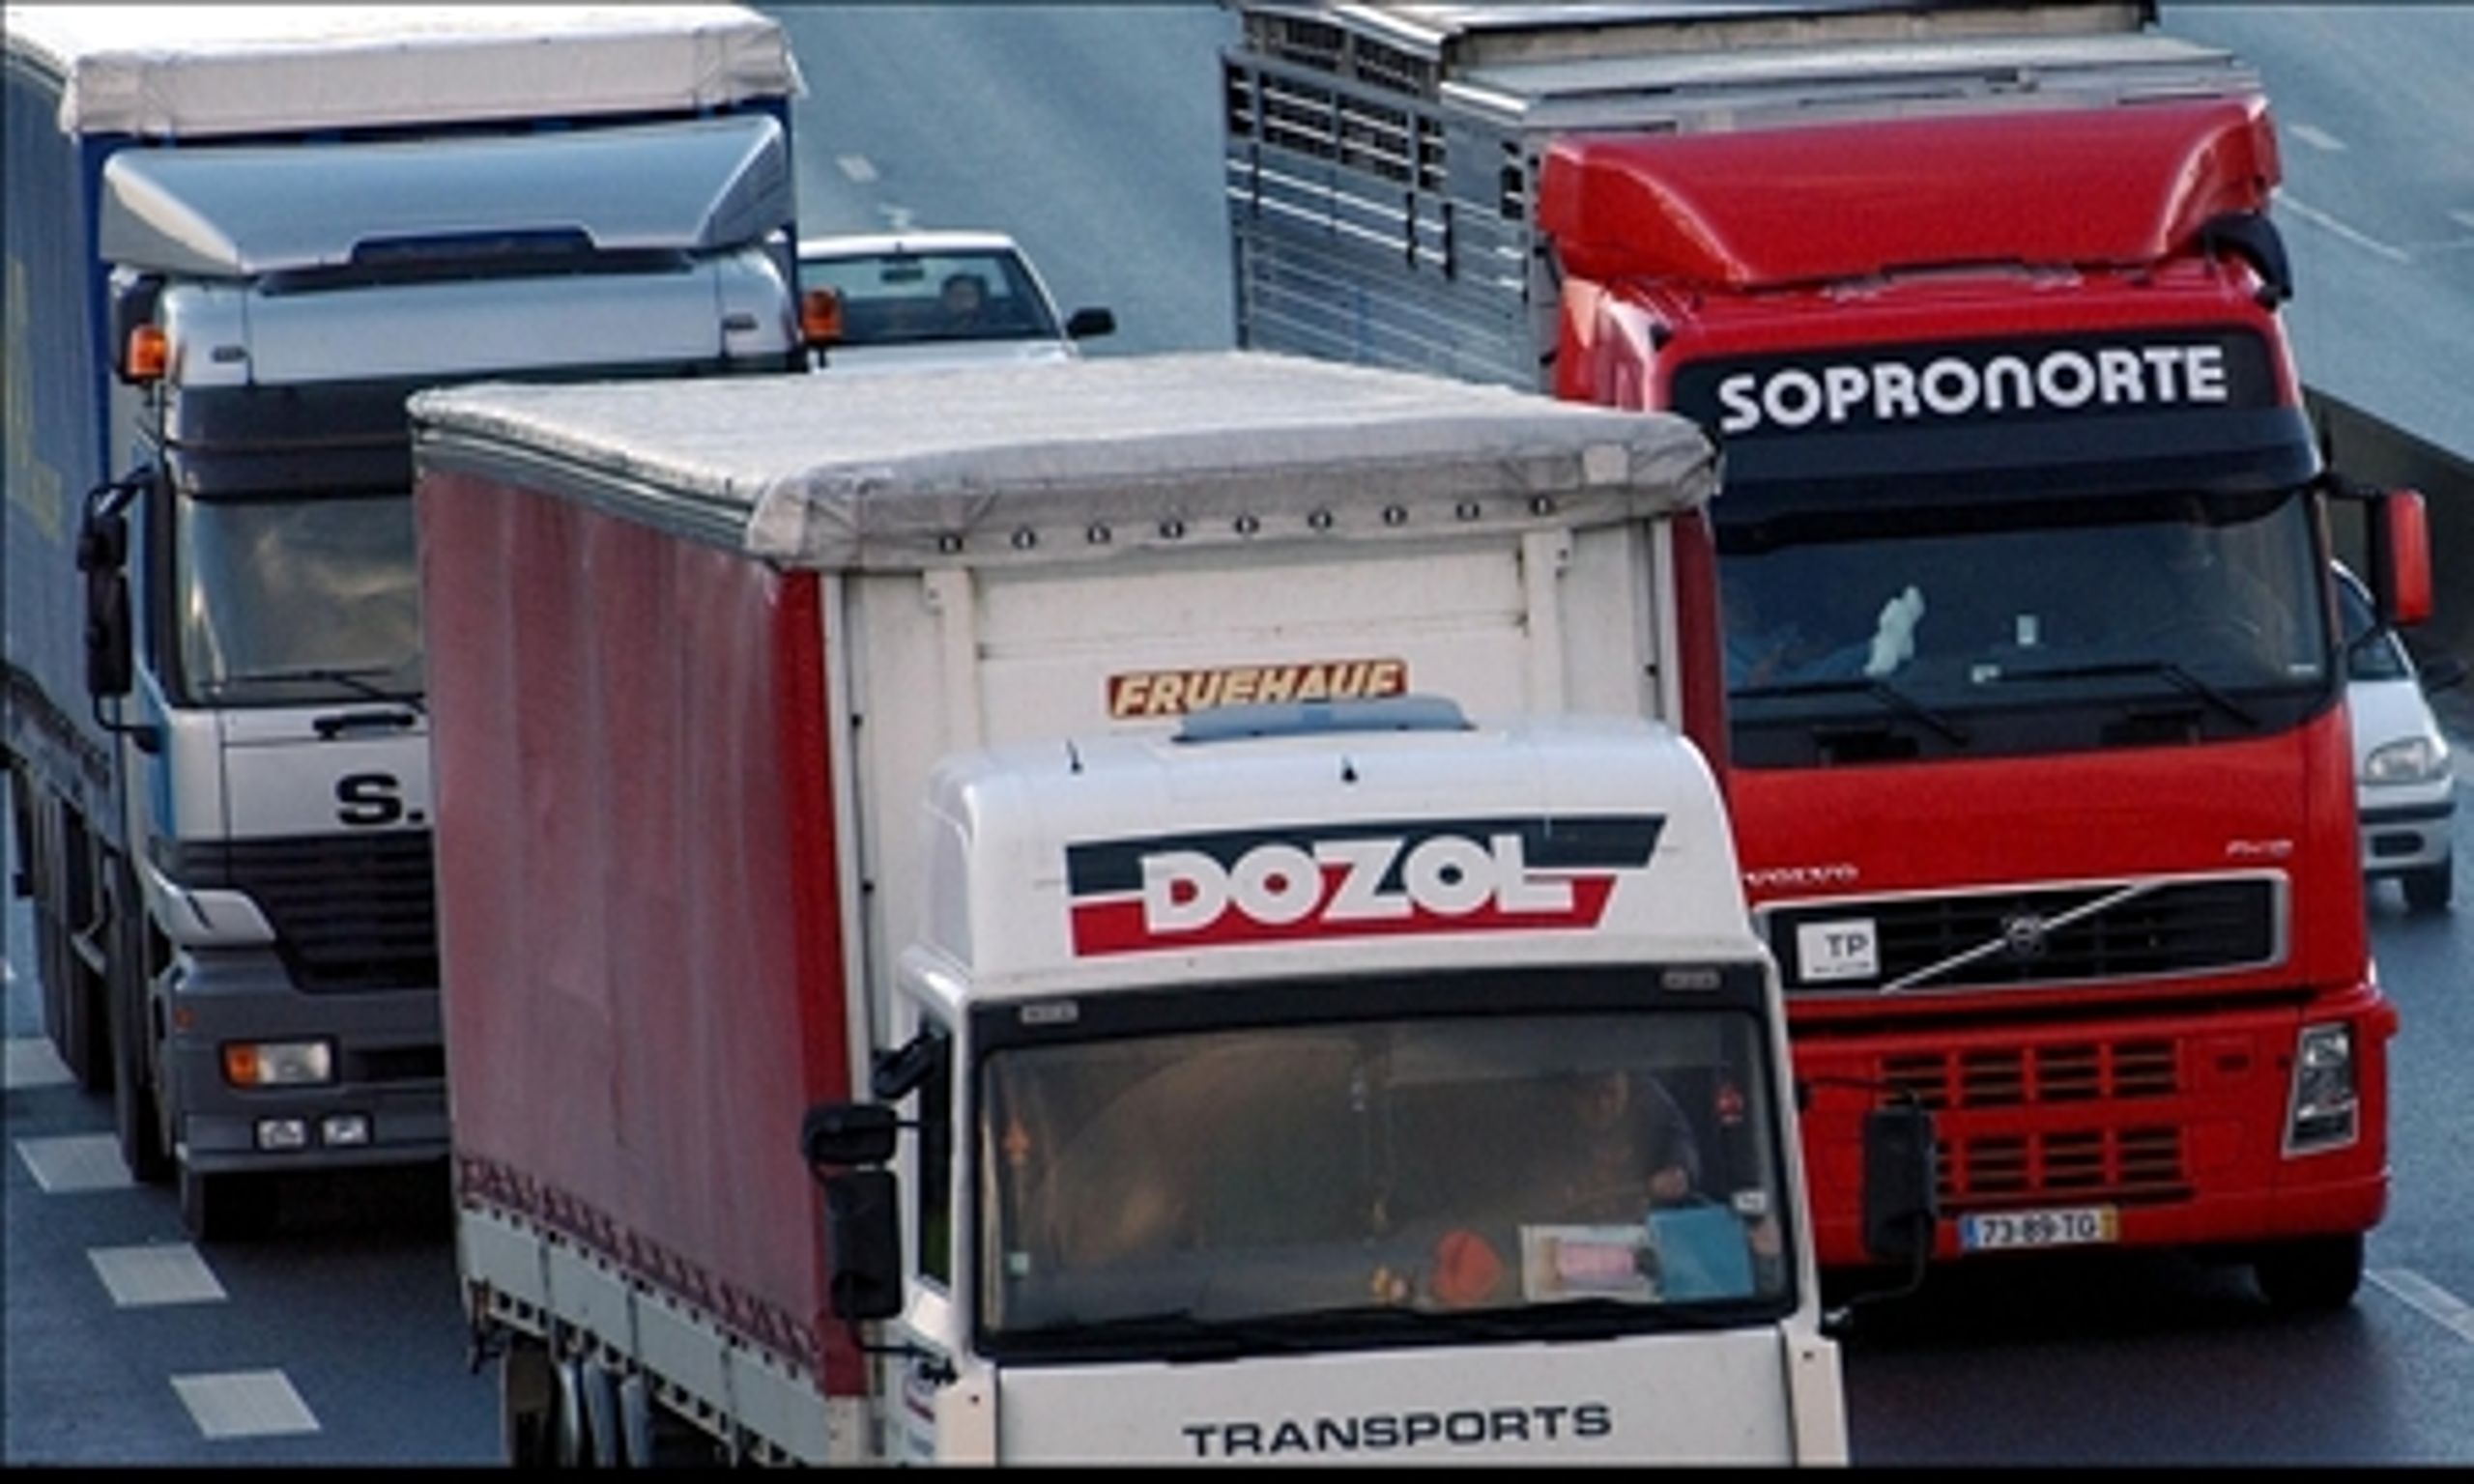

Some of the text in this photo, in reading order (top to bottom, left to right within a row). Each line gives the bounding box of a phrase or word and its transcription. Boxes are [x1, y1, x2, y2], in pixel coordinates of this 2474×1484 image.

[1718, 345, 2227, 434] SOPRONORTE
[1113, 661, 1401, 716] FRUEHAUF
[1141, 835, 1574, 934] DOZOL
[1825, 933, 1869, 957] TP
[1182, 1403, 1613, 1456] TRANSPORTS
